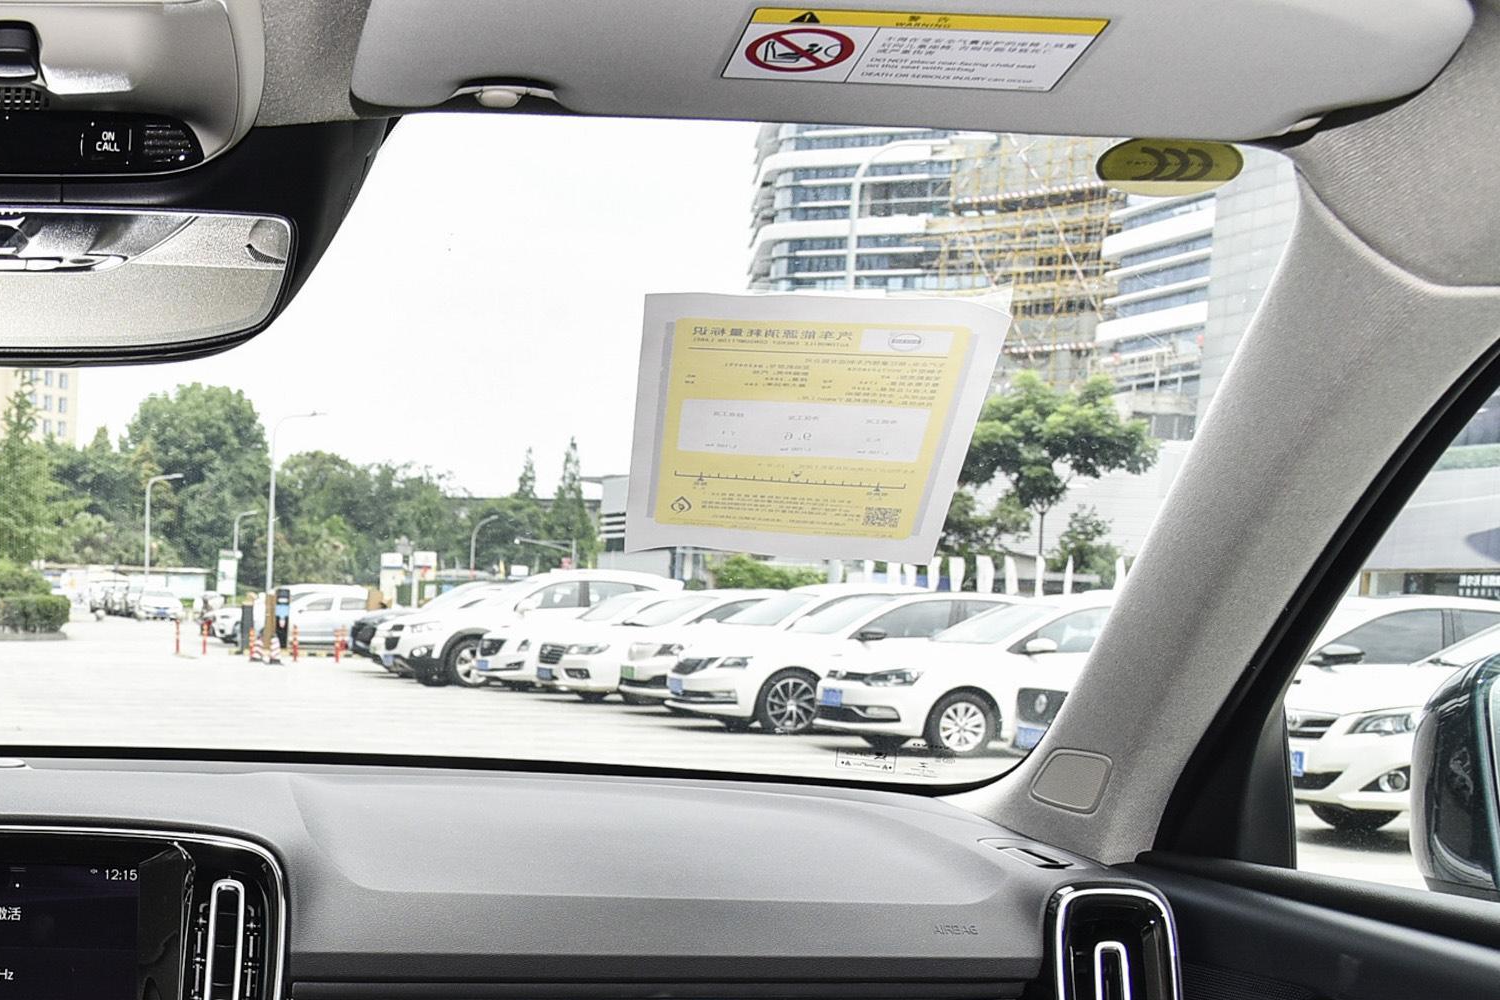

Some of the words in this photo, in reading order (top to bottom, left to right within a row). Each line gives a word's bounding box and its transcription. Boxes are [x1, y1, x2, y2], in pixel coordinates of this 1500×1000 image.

[102, 131, 115, 141] ON
[96, 141, 120, 152] CALL
[104, 869, 138, 881] 12:15
[933, 924, 979, 935] AIRBAG
